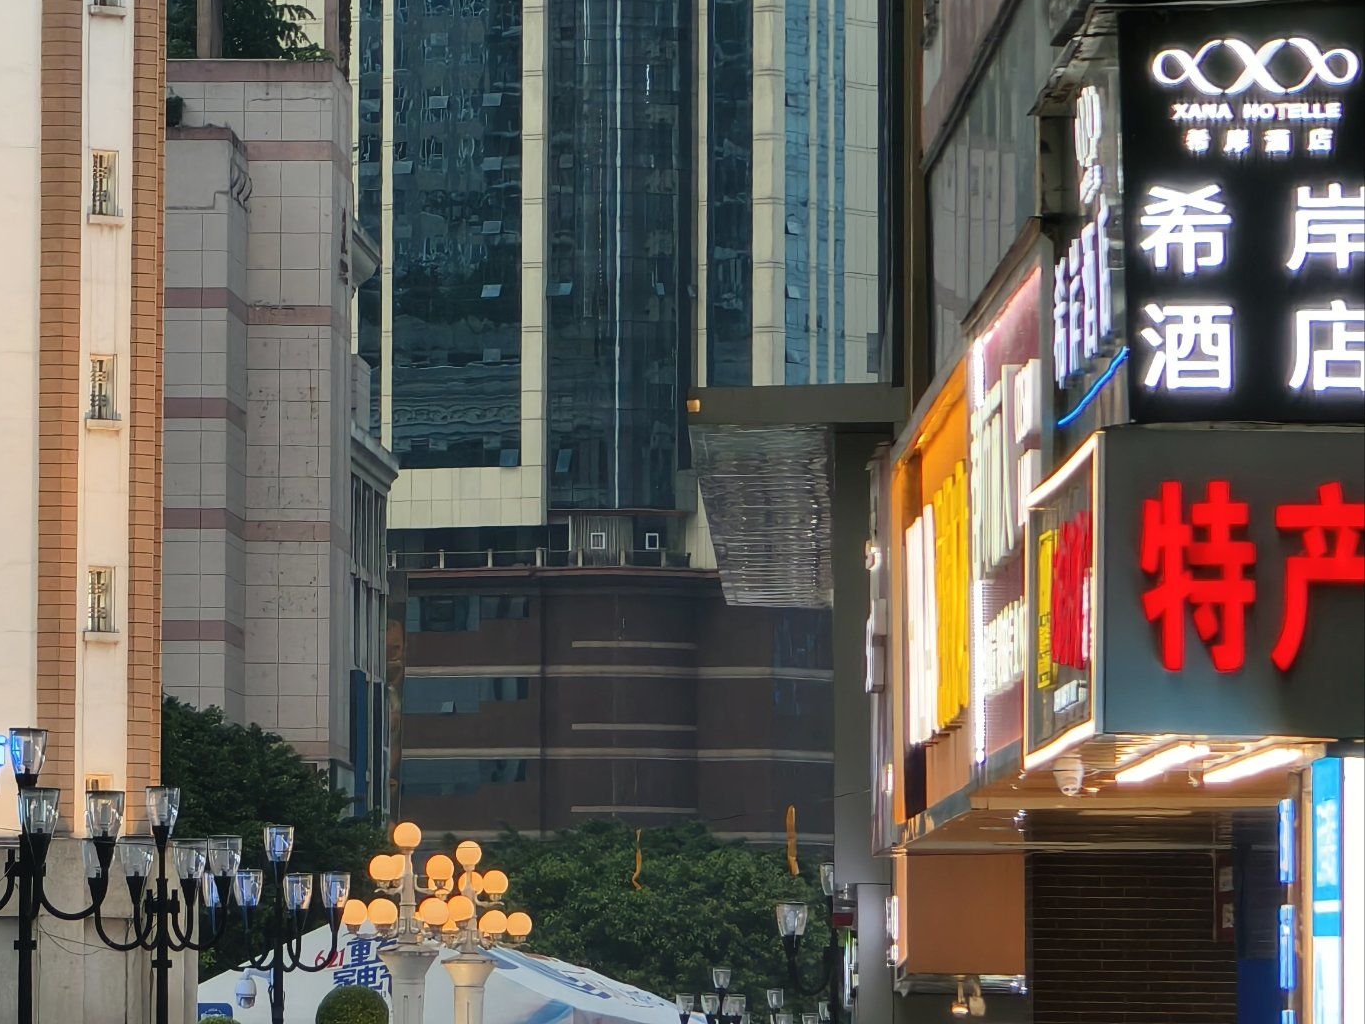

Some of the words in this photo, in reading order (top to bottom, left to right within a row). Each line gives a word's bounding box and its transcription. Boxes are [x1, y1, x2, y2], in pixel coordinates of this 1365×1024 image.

[1171, 102, 1234, 121] XANA
[1140, 182, 1365, 275] 希岸
[1140, 300, 1365, 392] 酒店
[1139, 480, 1365, 673] 特产
